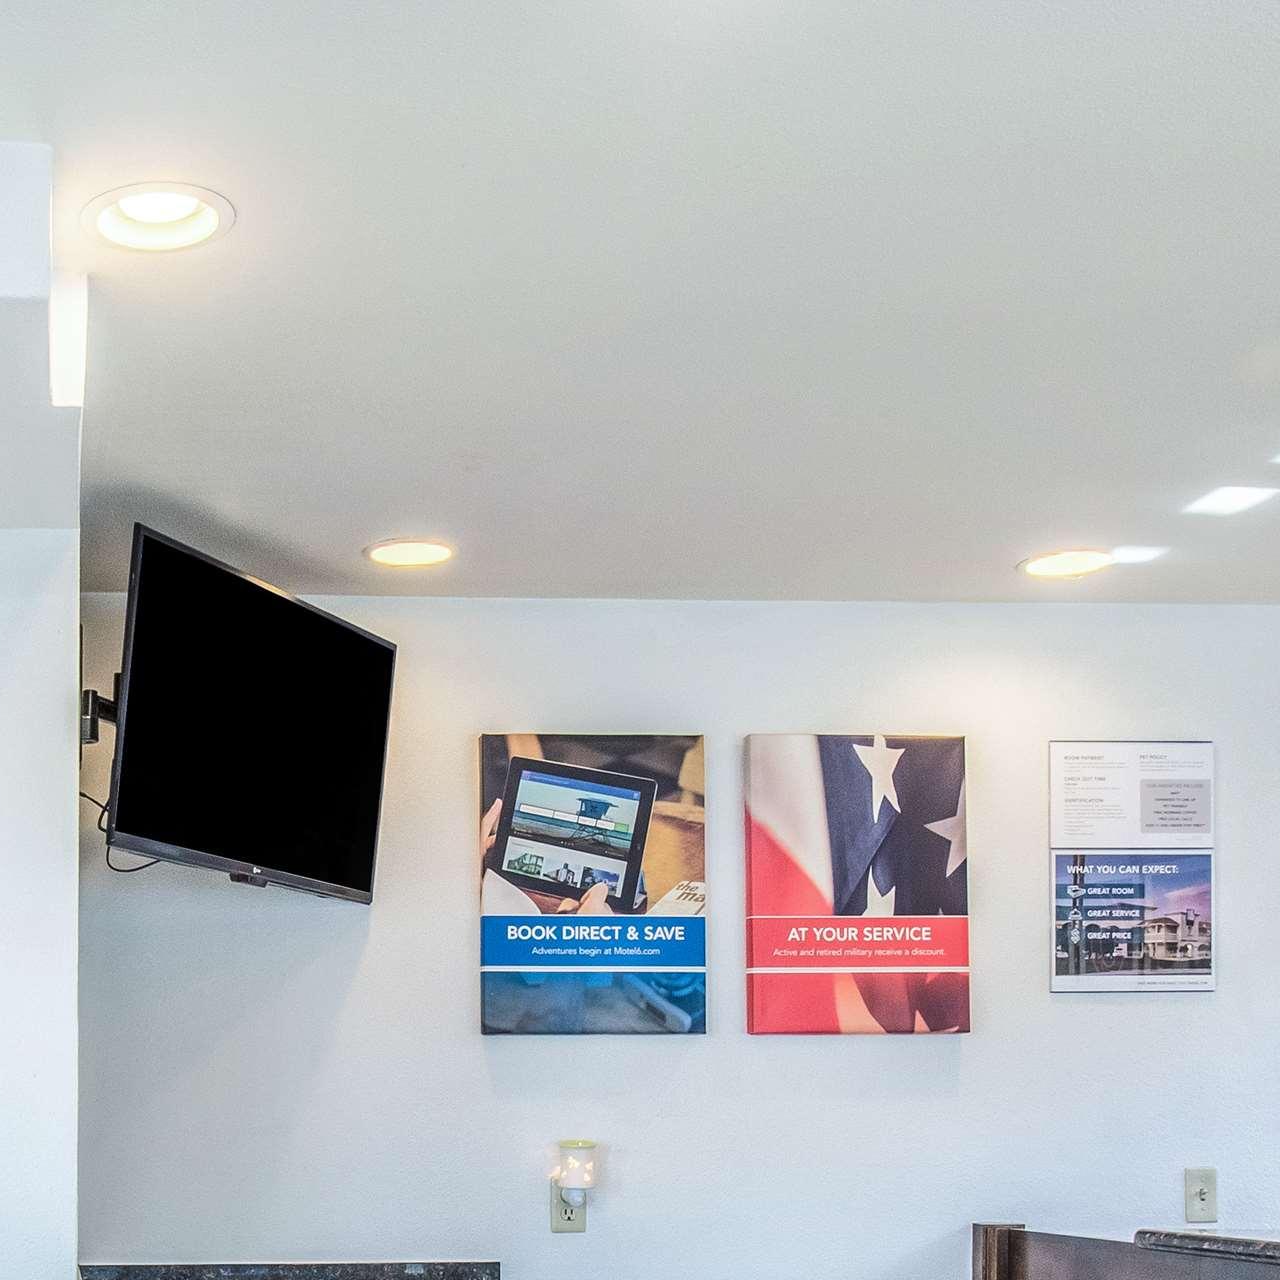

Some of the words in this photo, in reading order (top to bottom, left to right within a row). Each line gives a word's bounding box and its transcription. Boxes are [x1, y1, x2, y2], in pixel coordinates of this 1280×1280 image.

[1066, 865, 1095, 874] WHAT
[1096, 865, 1117, 874] YOU
[1118, 865, 1140, 874] CAN
[1142, 865, 1180, 874] EXPECT:
[1087, 910, 1110, 918] GREAT
[1111, 910, 1141, 918] SERVICE
[507, 925, 557, 941] BOOK
[562, 925, 622, 941] DIRECT
[626, 926, 639, 941] &
[644, 926, 685, 941] SAVE
[787, 927, 808, 941] AT
[812, 927, 859, 942] YOUR
[862, 926, 932, 942] SERVICE
[1087, 932, 1110, 940] GREAT
[1111, 932, 1132, 940] PRICE
[531, 946, 577, 956] Adventures
[578, 946, 603, 957] begin
[604, 947, 612, 956] at
[613, 946, 661, 956] Motel6.com
[773, 948, 797, 957] Active
[799, 948, 816, 956] and
[817, 948, 842, 956] retired
[844, 948, 873, 958] military
[874, 949, 903, 957] receive
